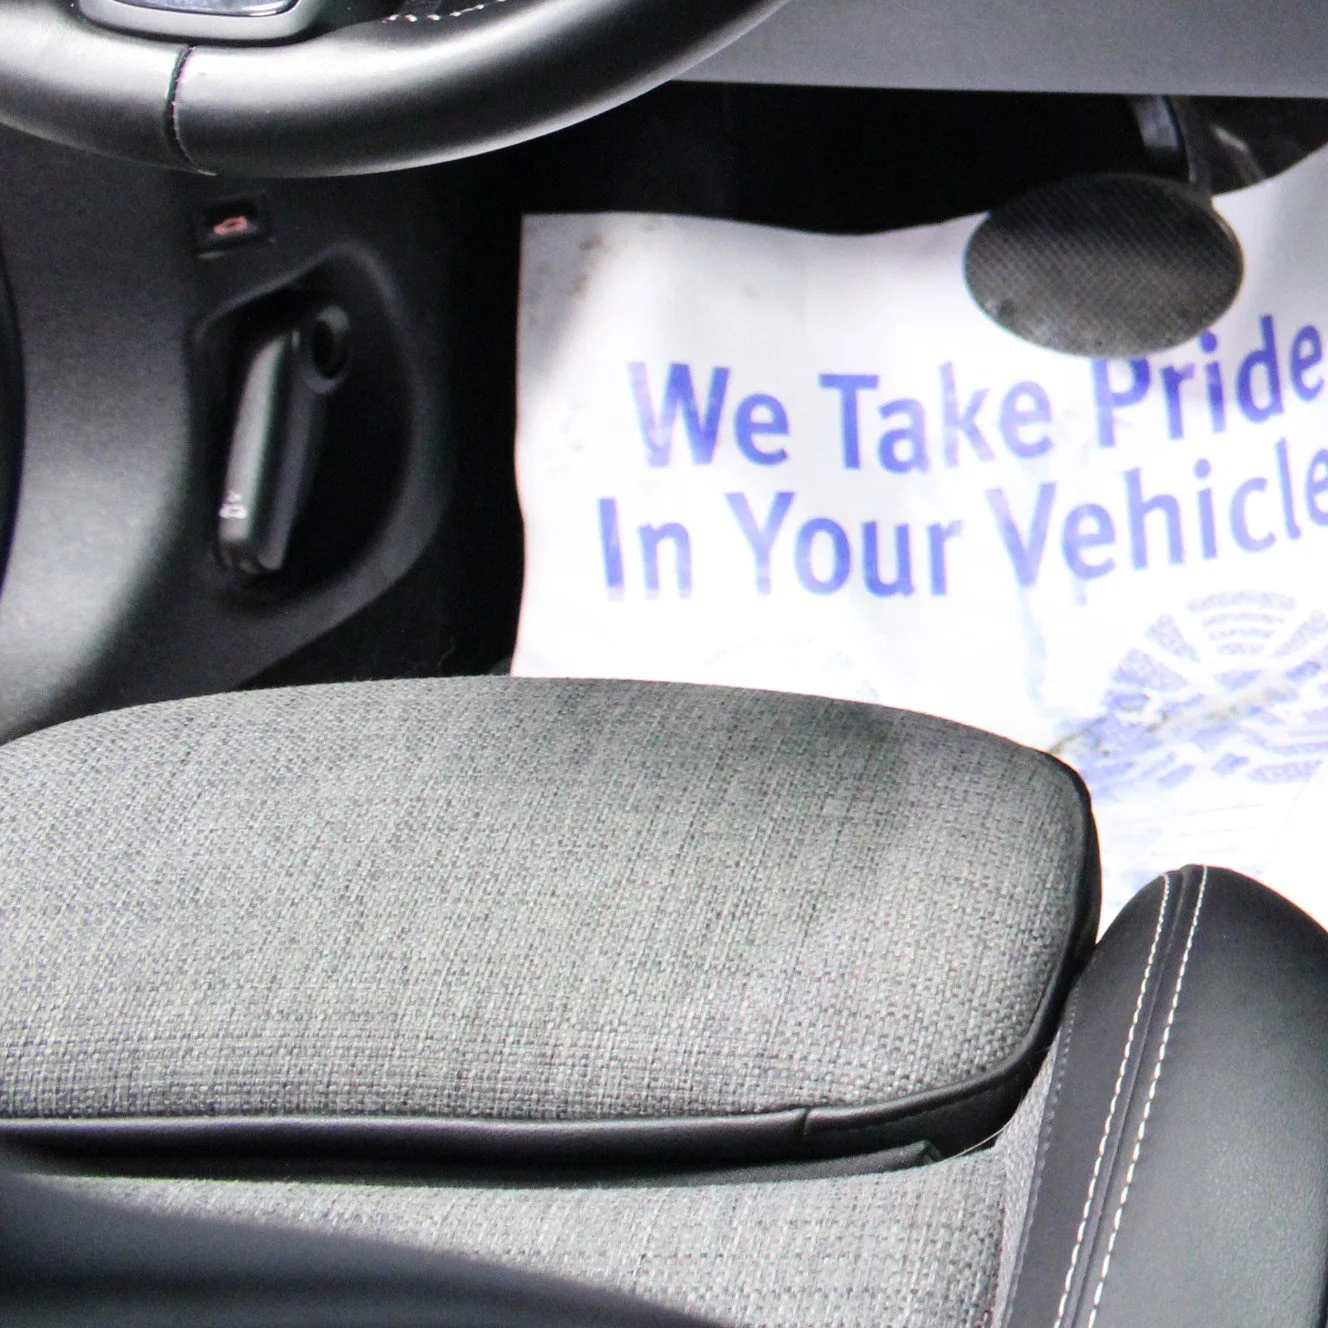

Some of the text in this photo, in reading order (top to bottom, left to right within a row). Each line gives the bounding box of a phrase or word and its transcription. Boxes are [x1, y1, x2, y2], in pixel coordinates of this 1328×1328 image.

[628, 313, 1325, 475] We Take Pride
[597, 497, 693, 601] In
[725, 490, 962, 599] Your
